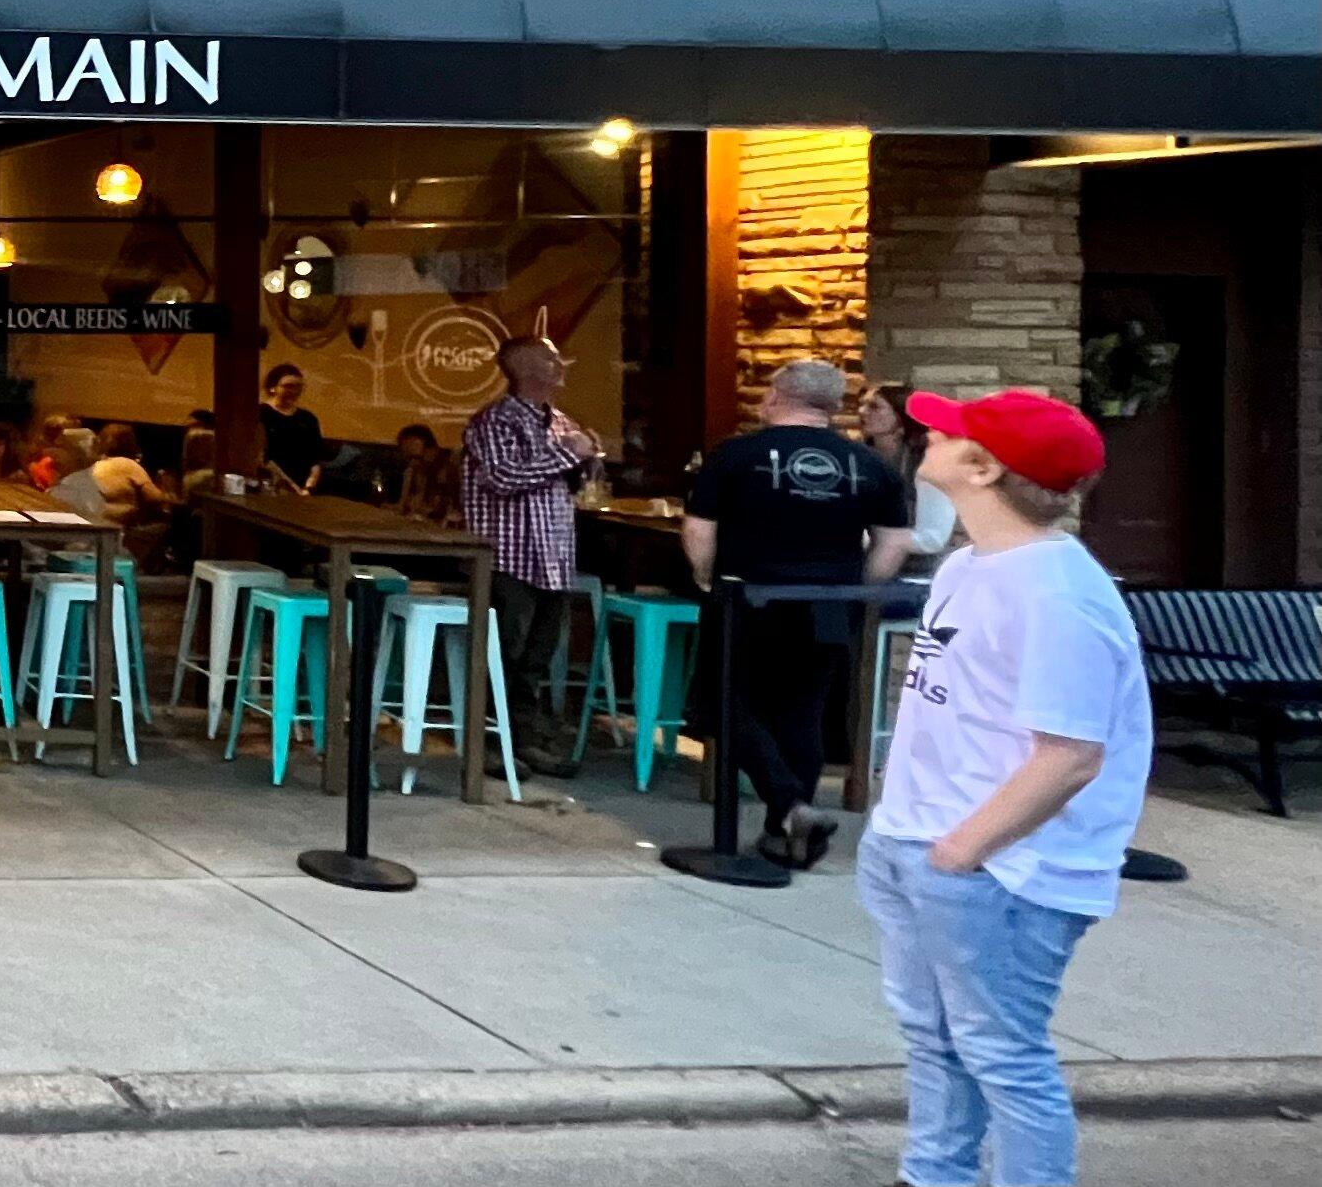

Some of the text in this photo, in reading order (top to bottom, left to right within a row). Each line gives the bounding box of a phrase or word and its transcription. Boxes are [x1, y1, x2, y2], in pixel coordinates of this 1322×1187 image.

[7, 308, 72, 329] LOCAL
[75, 308, 128, 329] BEERS
[142, 309, 194, 330] WINE
